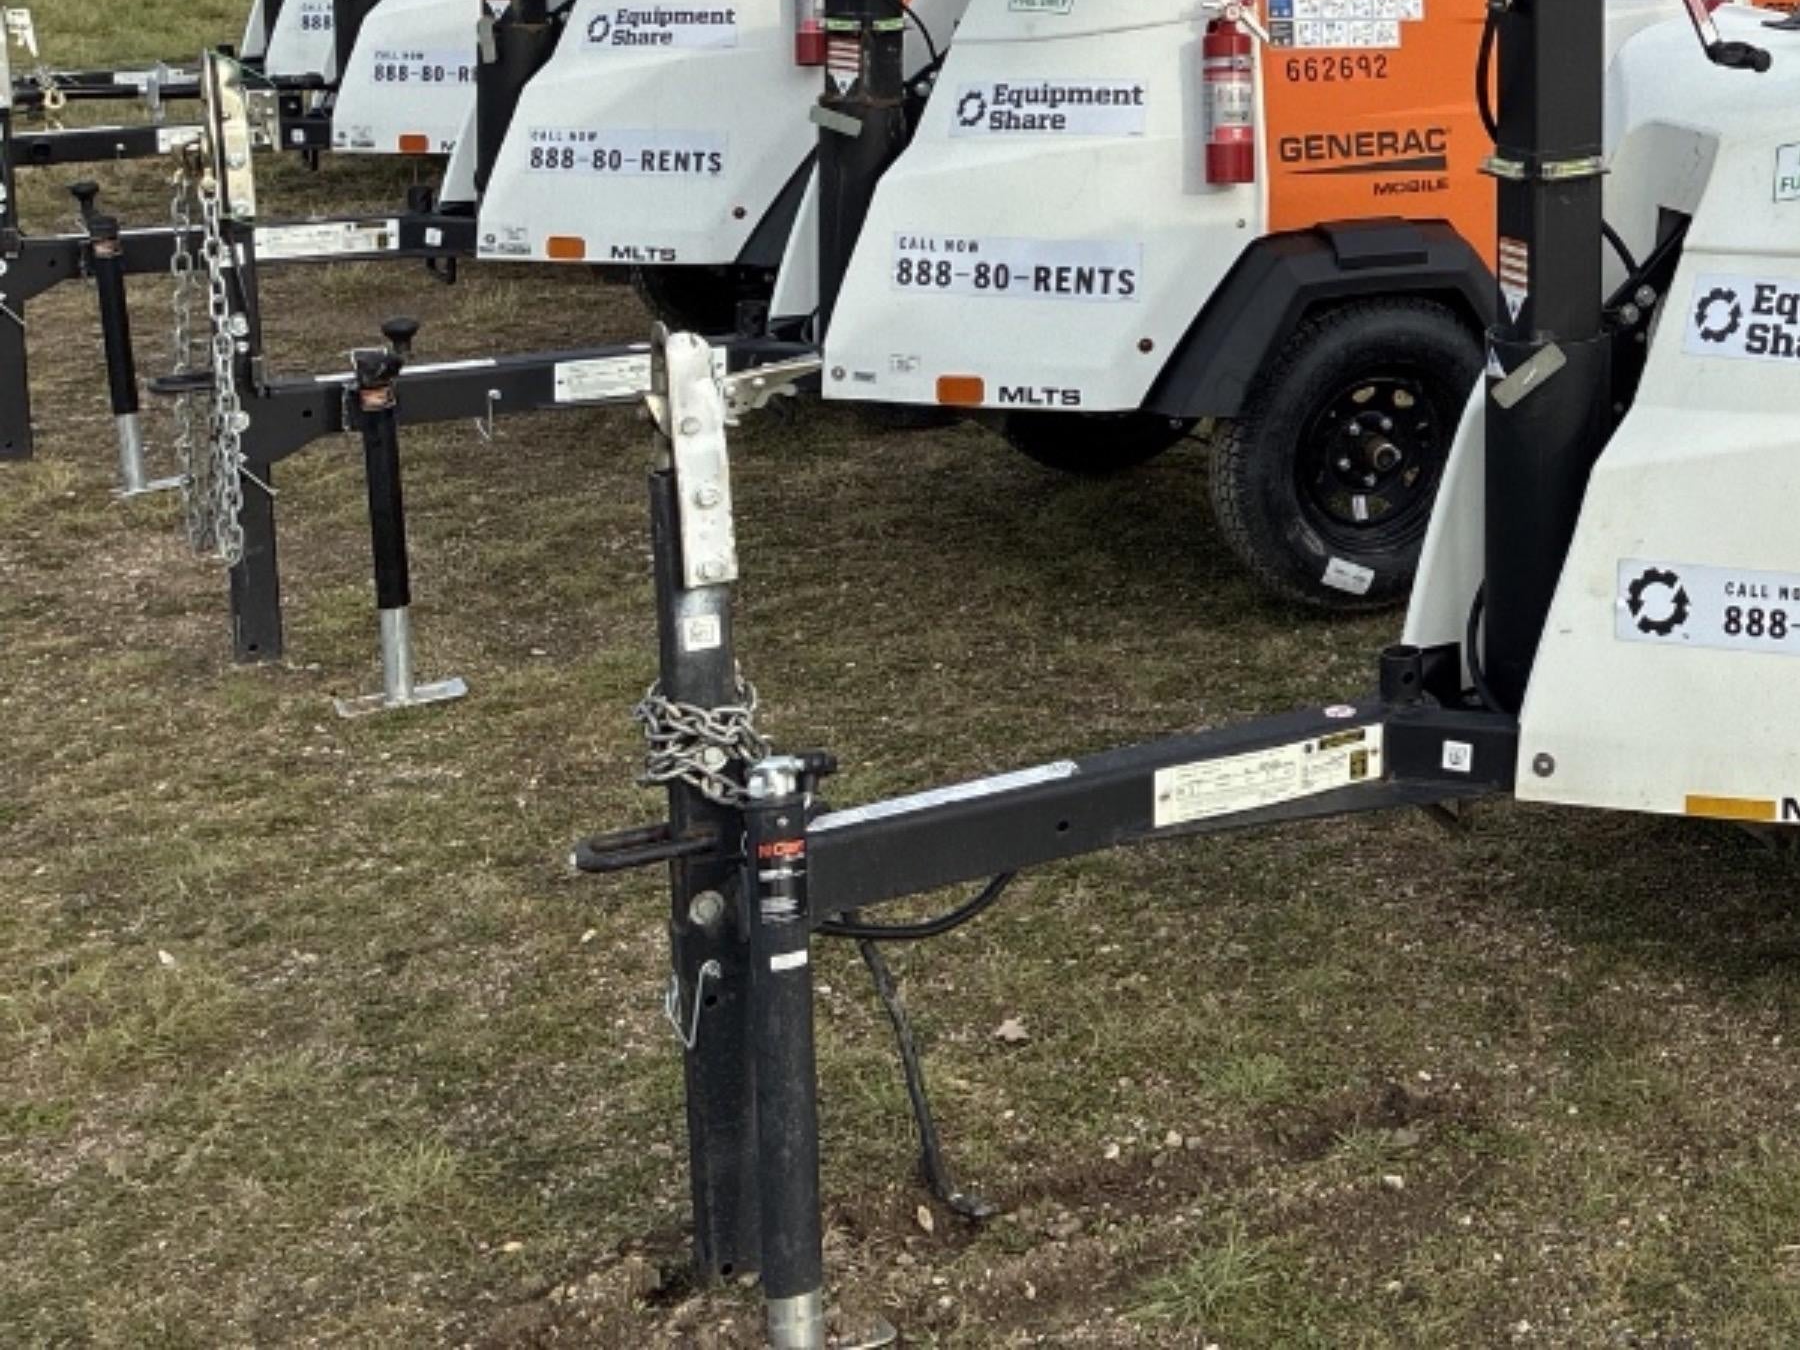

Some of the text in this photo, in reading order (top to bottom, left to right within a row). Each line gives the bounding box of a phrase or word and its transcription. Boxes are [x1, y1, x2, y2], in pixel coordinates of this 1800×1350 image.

[616, 7, 736, 28] Equipment
[611, 29, 673, 47] Share
[1285, 54, 1389, 83] 662692
[992, 81, 1145, 111] Equipment
[988, 108, 1067, 132] Share
[1279, 126, 1447, 164] GENERAC
[529, 146, 722, 174] 888-80-RENTS
[1372, 177, 1450, 197] MOBILE
[898, 236, 980, 254] CALL NOW
[896, 257, 1136, 296] 888-80-RENTS
[998, 385, 1082, 406] MLTS
[1724, 581, 1769, 600] CALL
